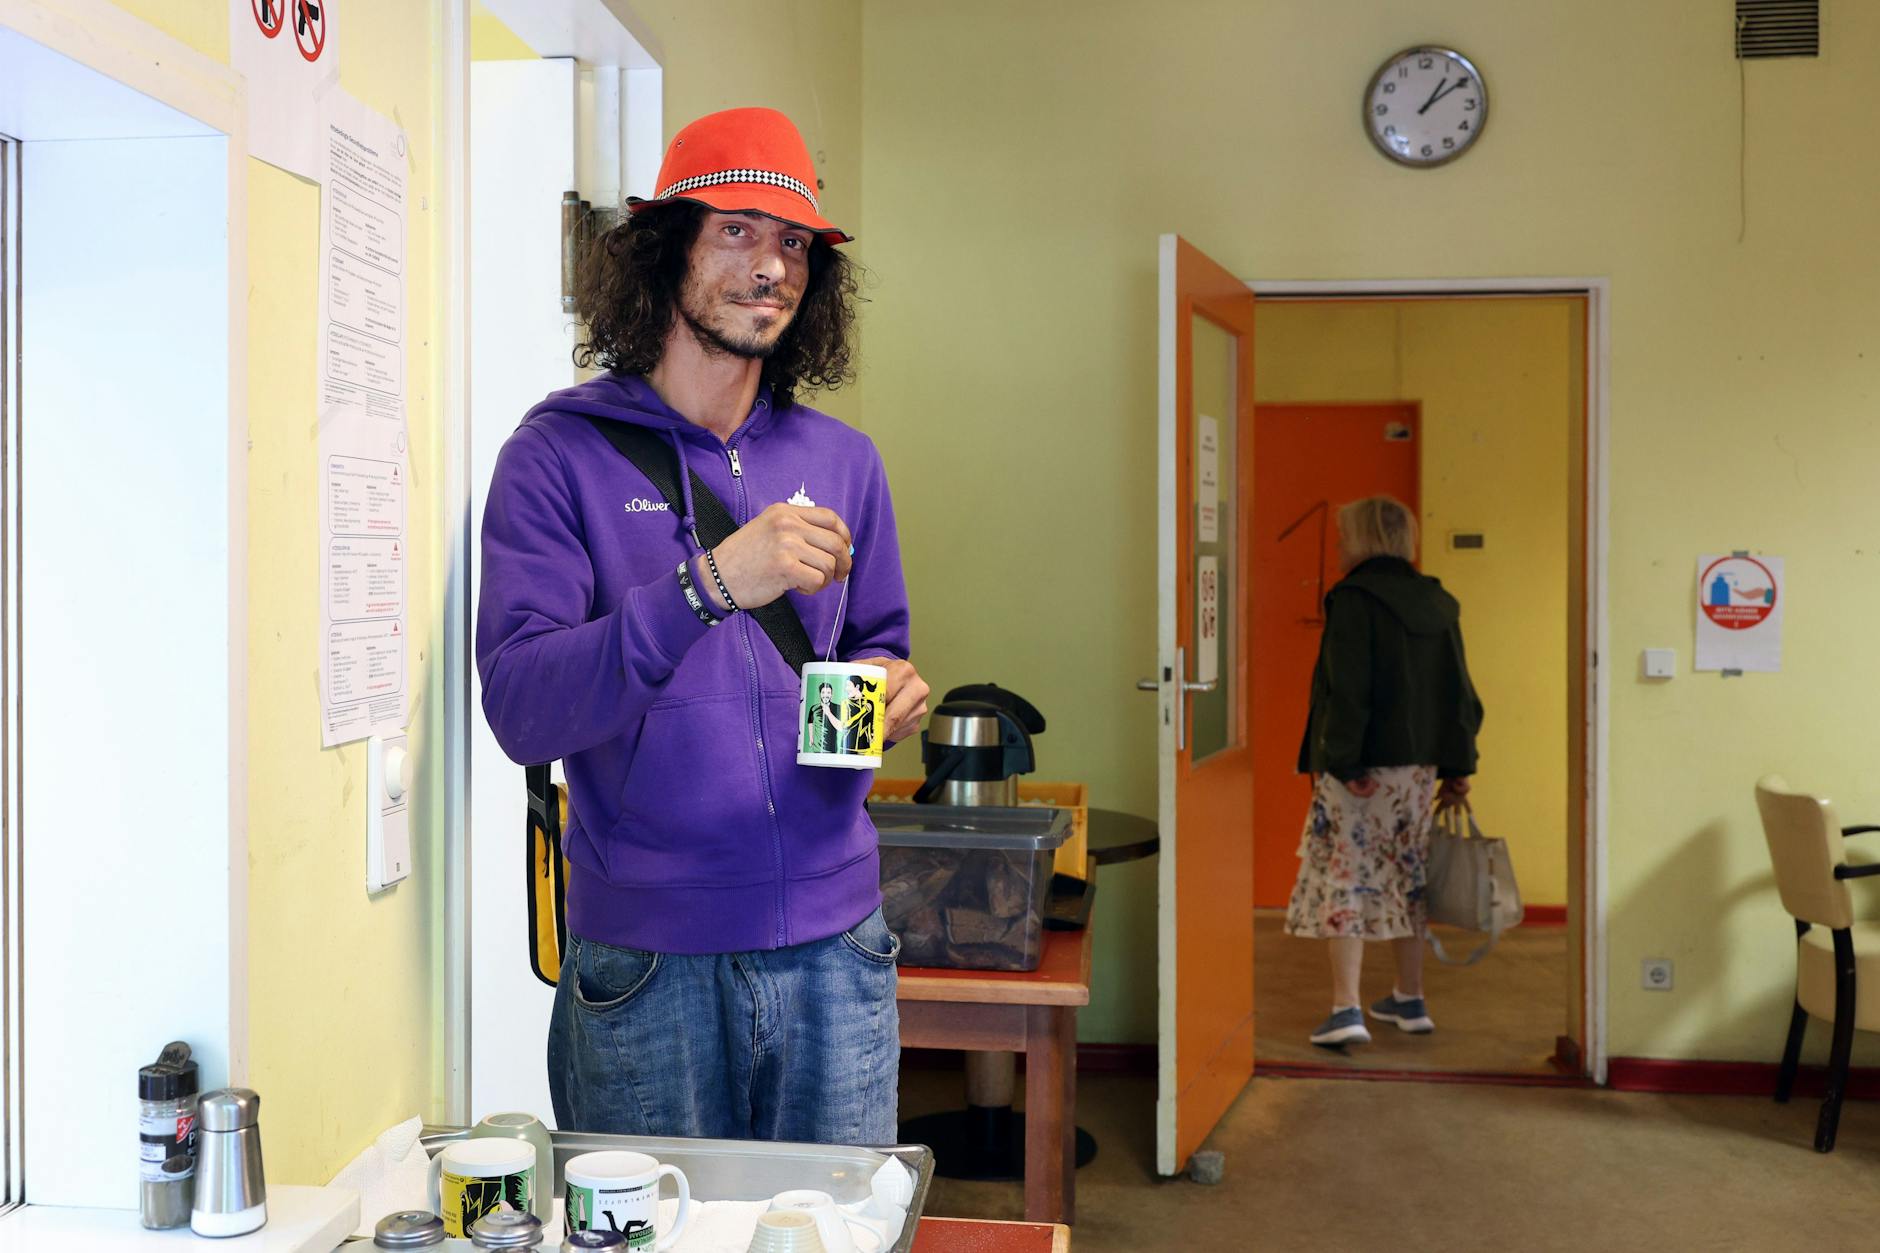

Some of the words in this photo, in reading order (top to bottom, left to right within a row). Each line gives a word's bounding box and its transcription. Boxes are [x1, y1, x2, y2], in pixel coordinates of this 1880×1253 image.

[1418, 58, 1433, 70] 12
[1398, 67, 1408, 78] 11
[1384, 82, 1395, 93] 10
[1376, 104, 1388, 115] 9
[1464, 99, 1476, 111] 3
[1458, 120, 1469, 131] 4
[1442, 137, 1455, 149] 5
[1421, 144, 1433, 157] 6
[625, 498, 670, 512] s.Oliver
